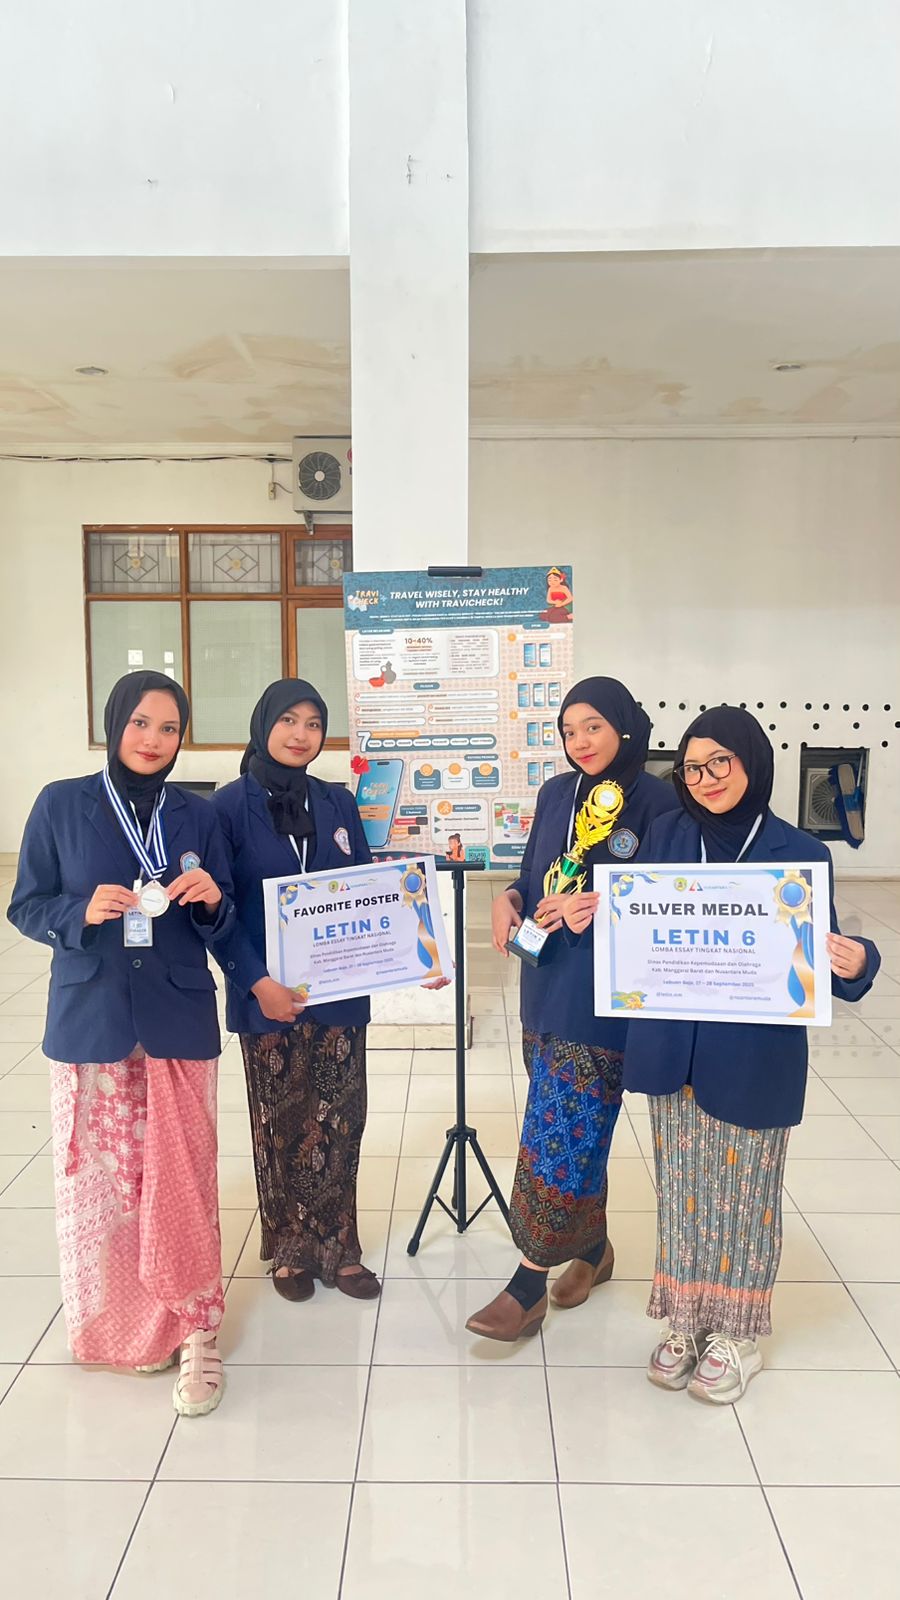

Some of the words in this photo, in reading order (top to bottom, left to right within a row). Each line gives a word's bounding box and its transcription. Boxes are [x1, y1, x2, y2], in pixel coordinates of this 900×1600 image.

[356, 590, 379, 598] TRAVI
[390, 592, 423, 600] TRAVEL
[425, 590, 460, 599] WISELY,
[462, 588, 487, 597] STAY
[488, 587, 530, 596] HEALTHY
[416, 600, 440, 609] WITH
[442, 598, 504, 608] TRAVICHECK!
[358, 731, 370, 752] 7
[294, 901, 352, 918] FAVORITE
[355, 894, 400, 908] POSTER
[629, 902, 696, 916] SILVER
[702, 903, 769, 917] MEDAL
[313, 918, 371, 941] LETIN
[380, 916, 390, 929] 6
[653, 928, 729, 945] LETIN
[742, 930, 756, 946] 6
